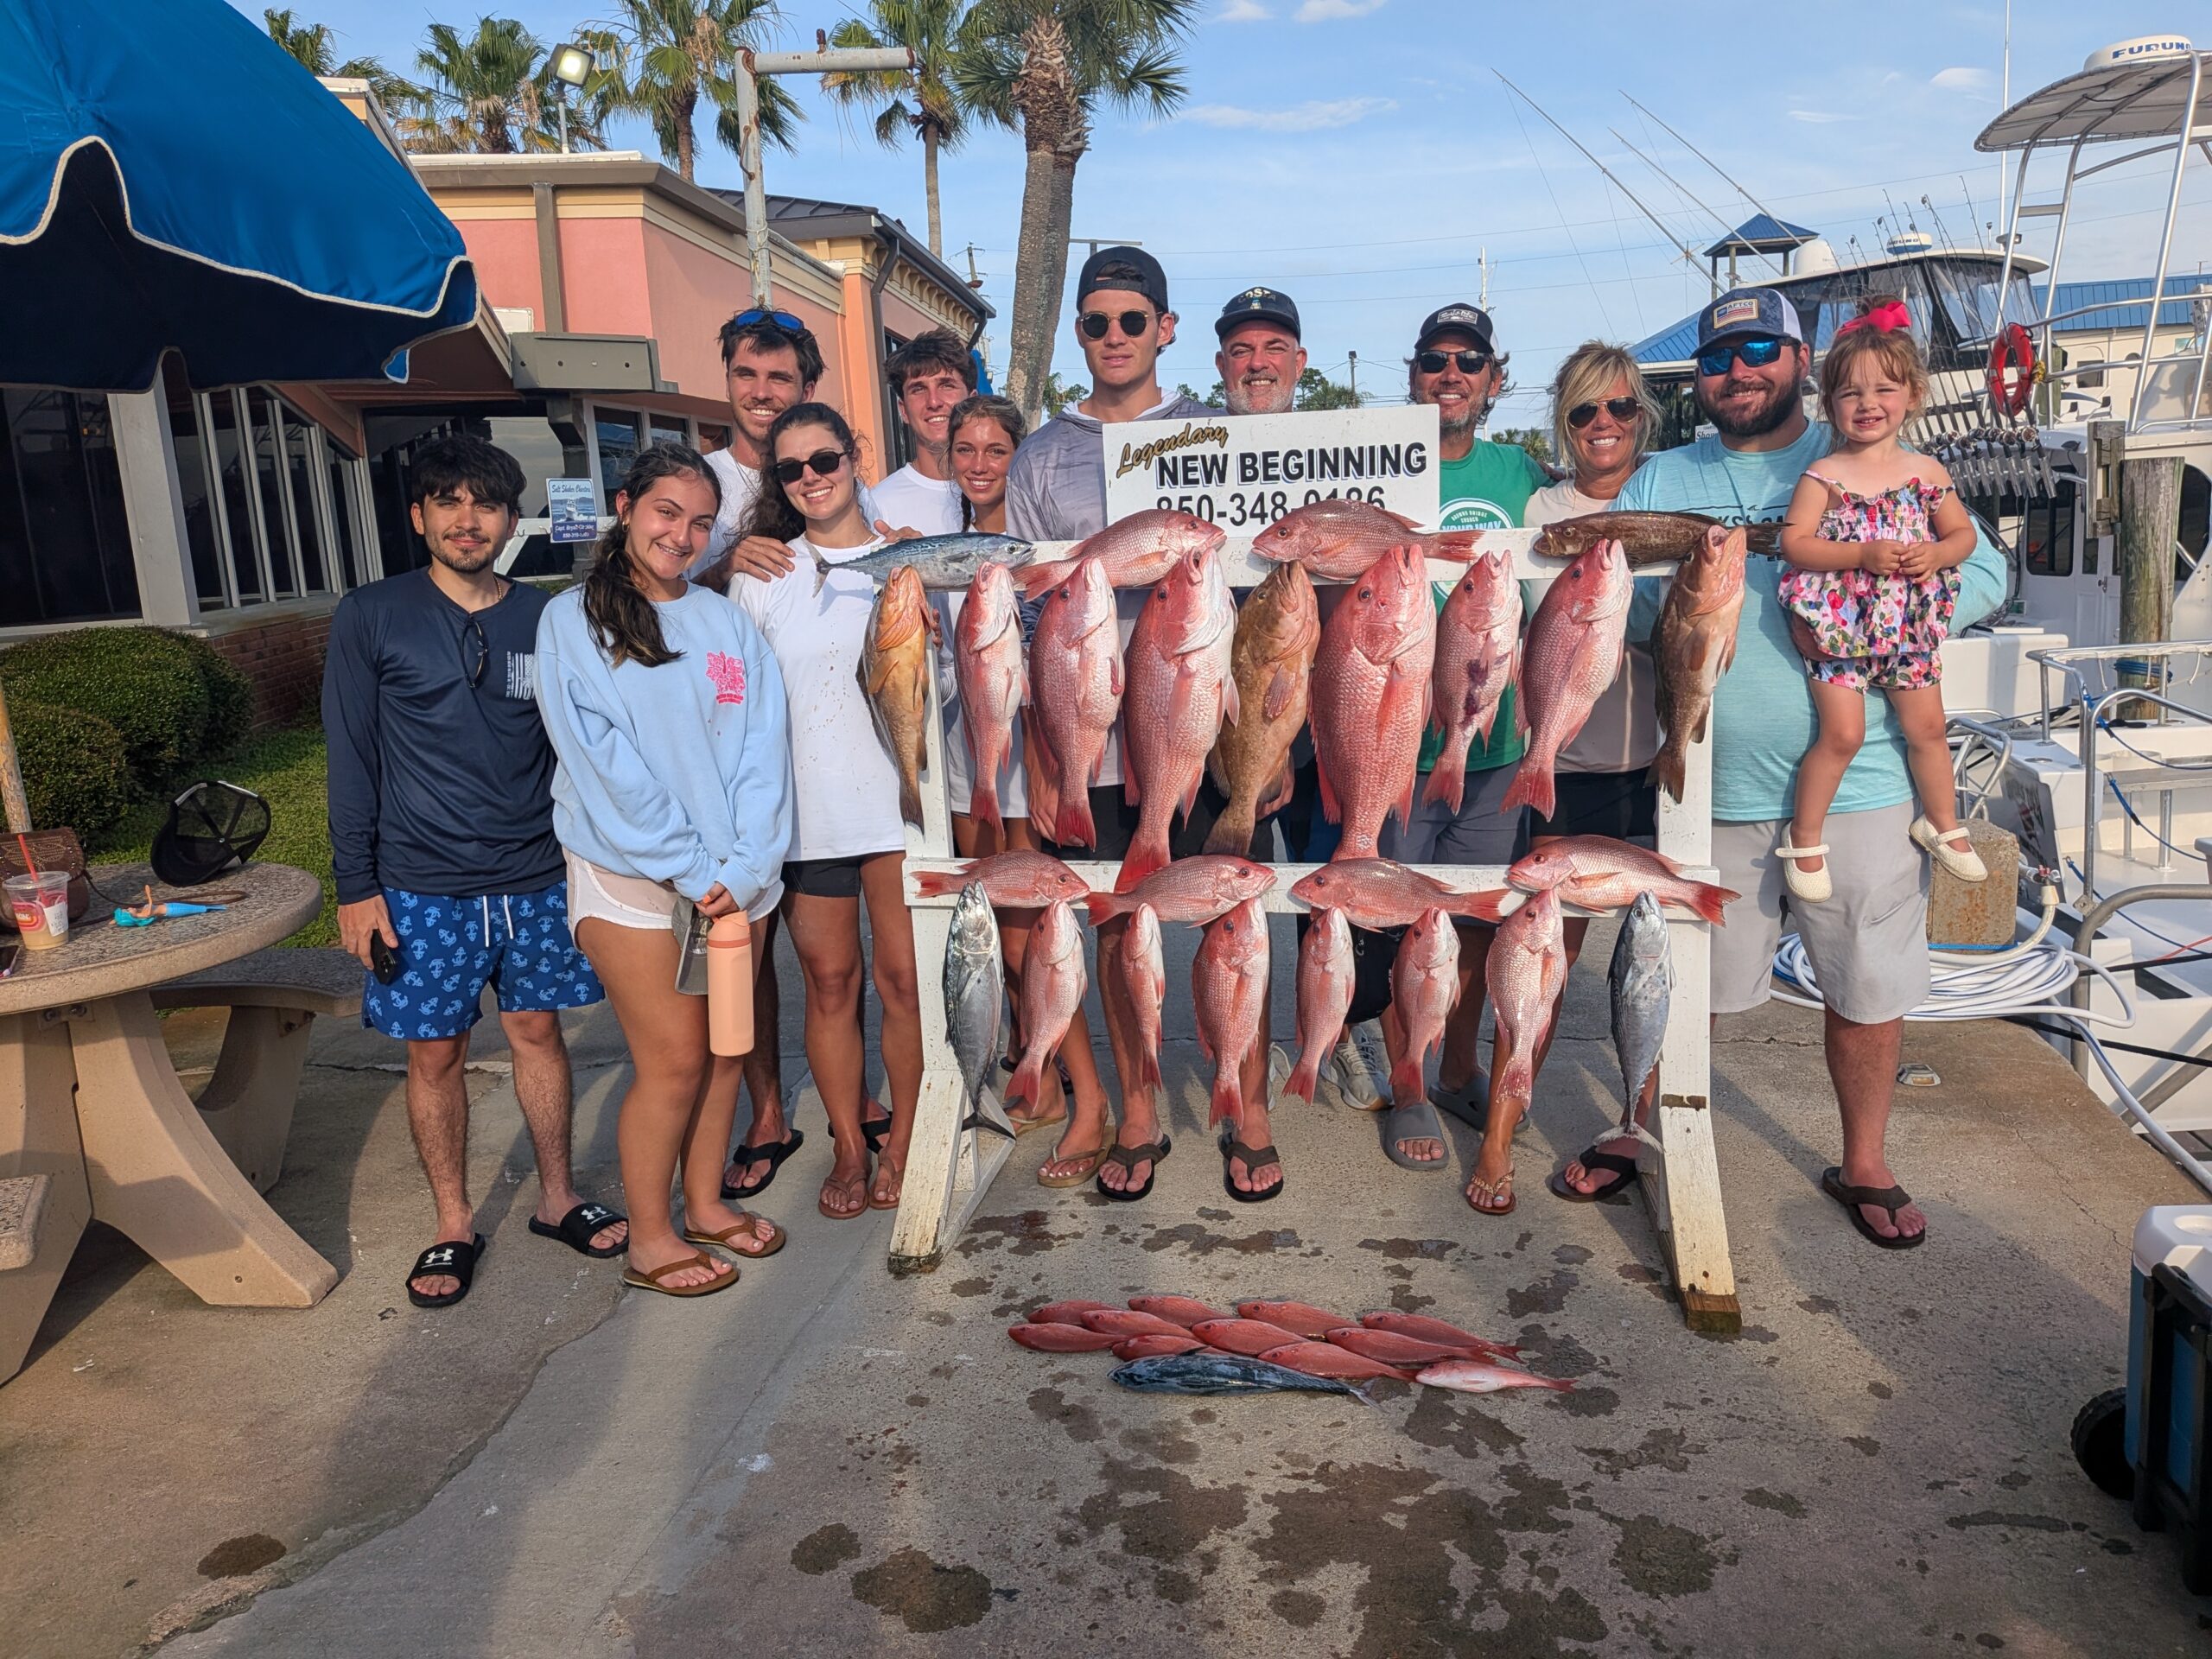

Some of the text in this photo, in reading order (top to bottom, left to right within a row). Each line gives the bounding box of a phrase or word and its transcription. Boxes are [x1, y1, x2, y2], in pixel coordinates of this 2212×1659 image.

[1727, 301, 1754, 309] AFTCO
[1116, 423, 1229, 479] Legendary
[1155, 442, 1427, 489] NEW BEGINNING
[1475, 520, 1501, 530] WAY
